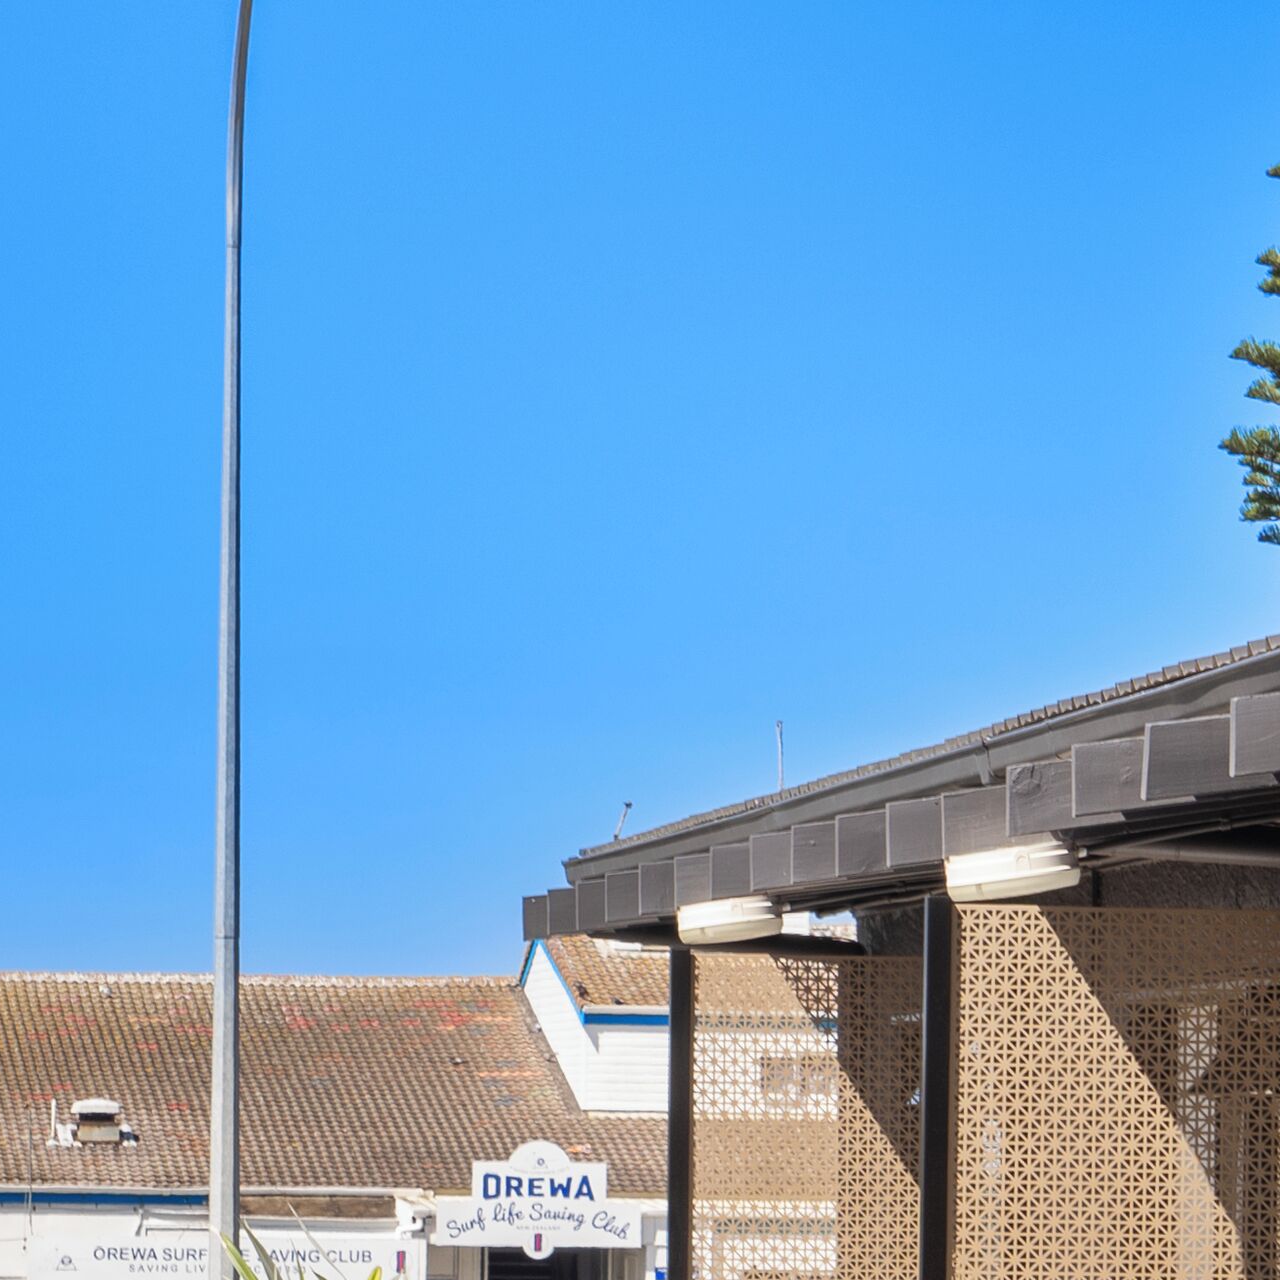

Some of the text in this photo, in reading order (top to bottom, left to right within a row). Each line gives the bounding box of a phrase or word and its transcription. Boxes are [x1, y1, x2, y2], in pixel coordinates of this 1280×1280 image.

[482, 1173, 596, 1201] OREWA
[446, 1208, 487, 1239] Surf
[528, 1203, 586, 1231] Saving
[592, 1211, 631, 1240] Club
[162, 1247, 208, 1262] SURF
[257, 1249, 320, 1263] AVING
[326, 1249, 373, 1263] CLUB
[129, 1264, 178, 1274] SAVING
[185, 1264, 206, 1274] LIV
